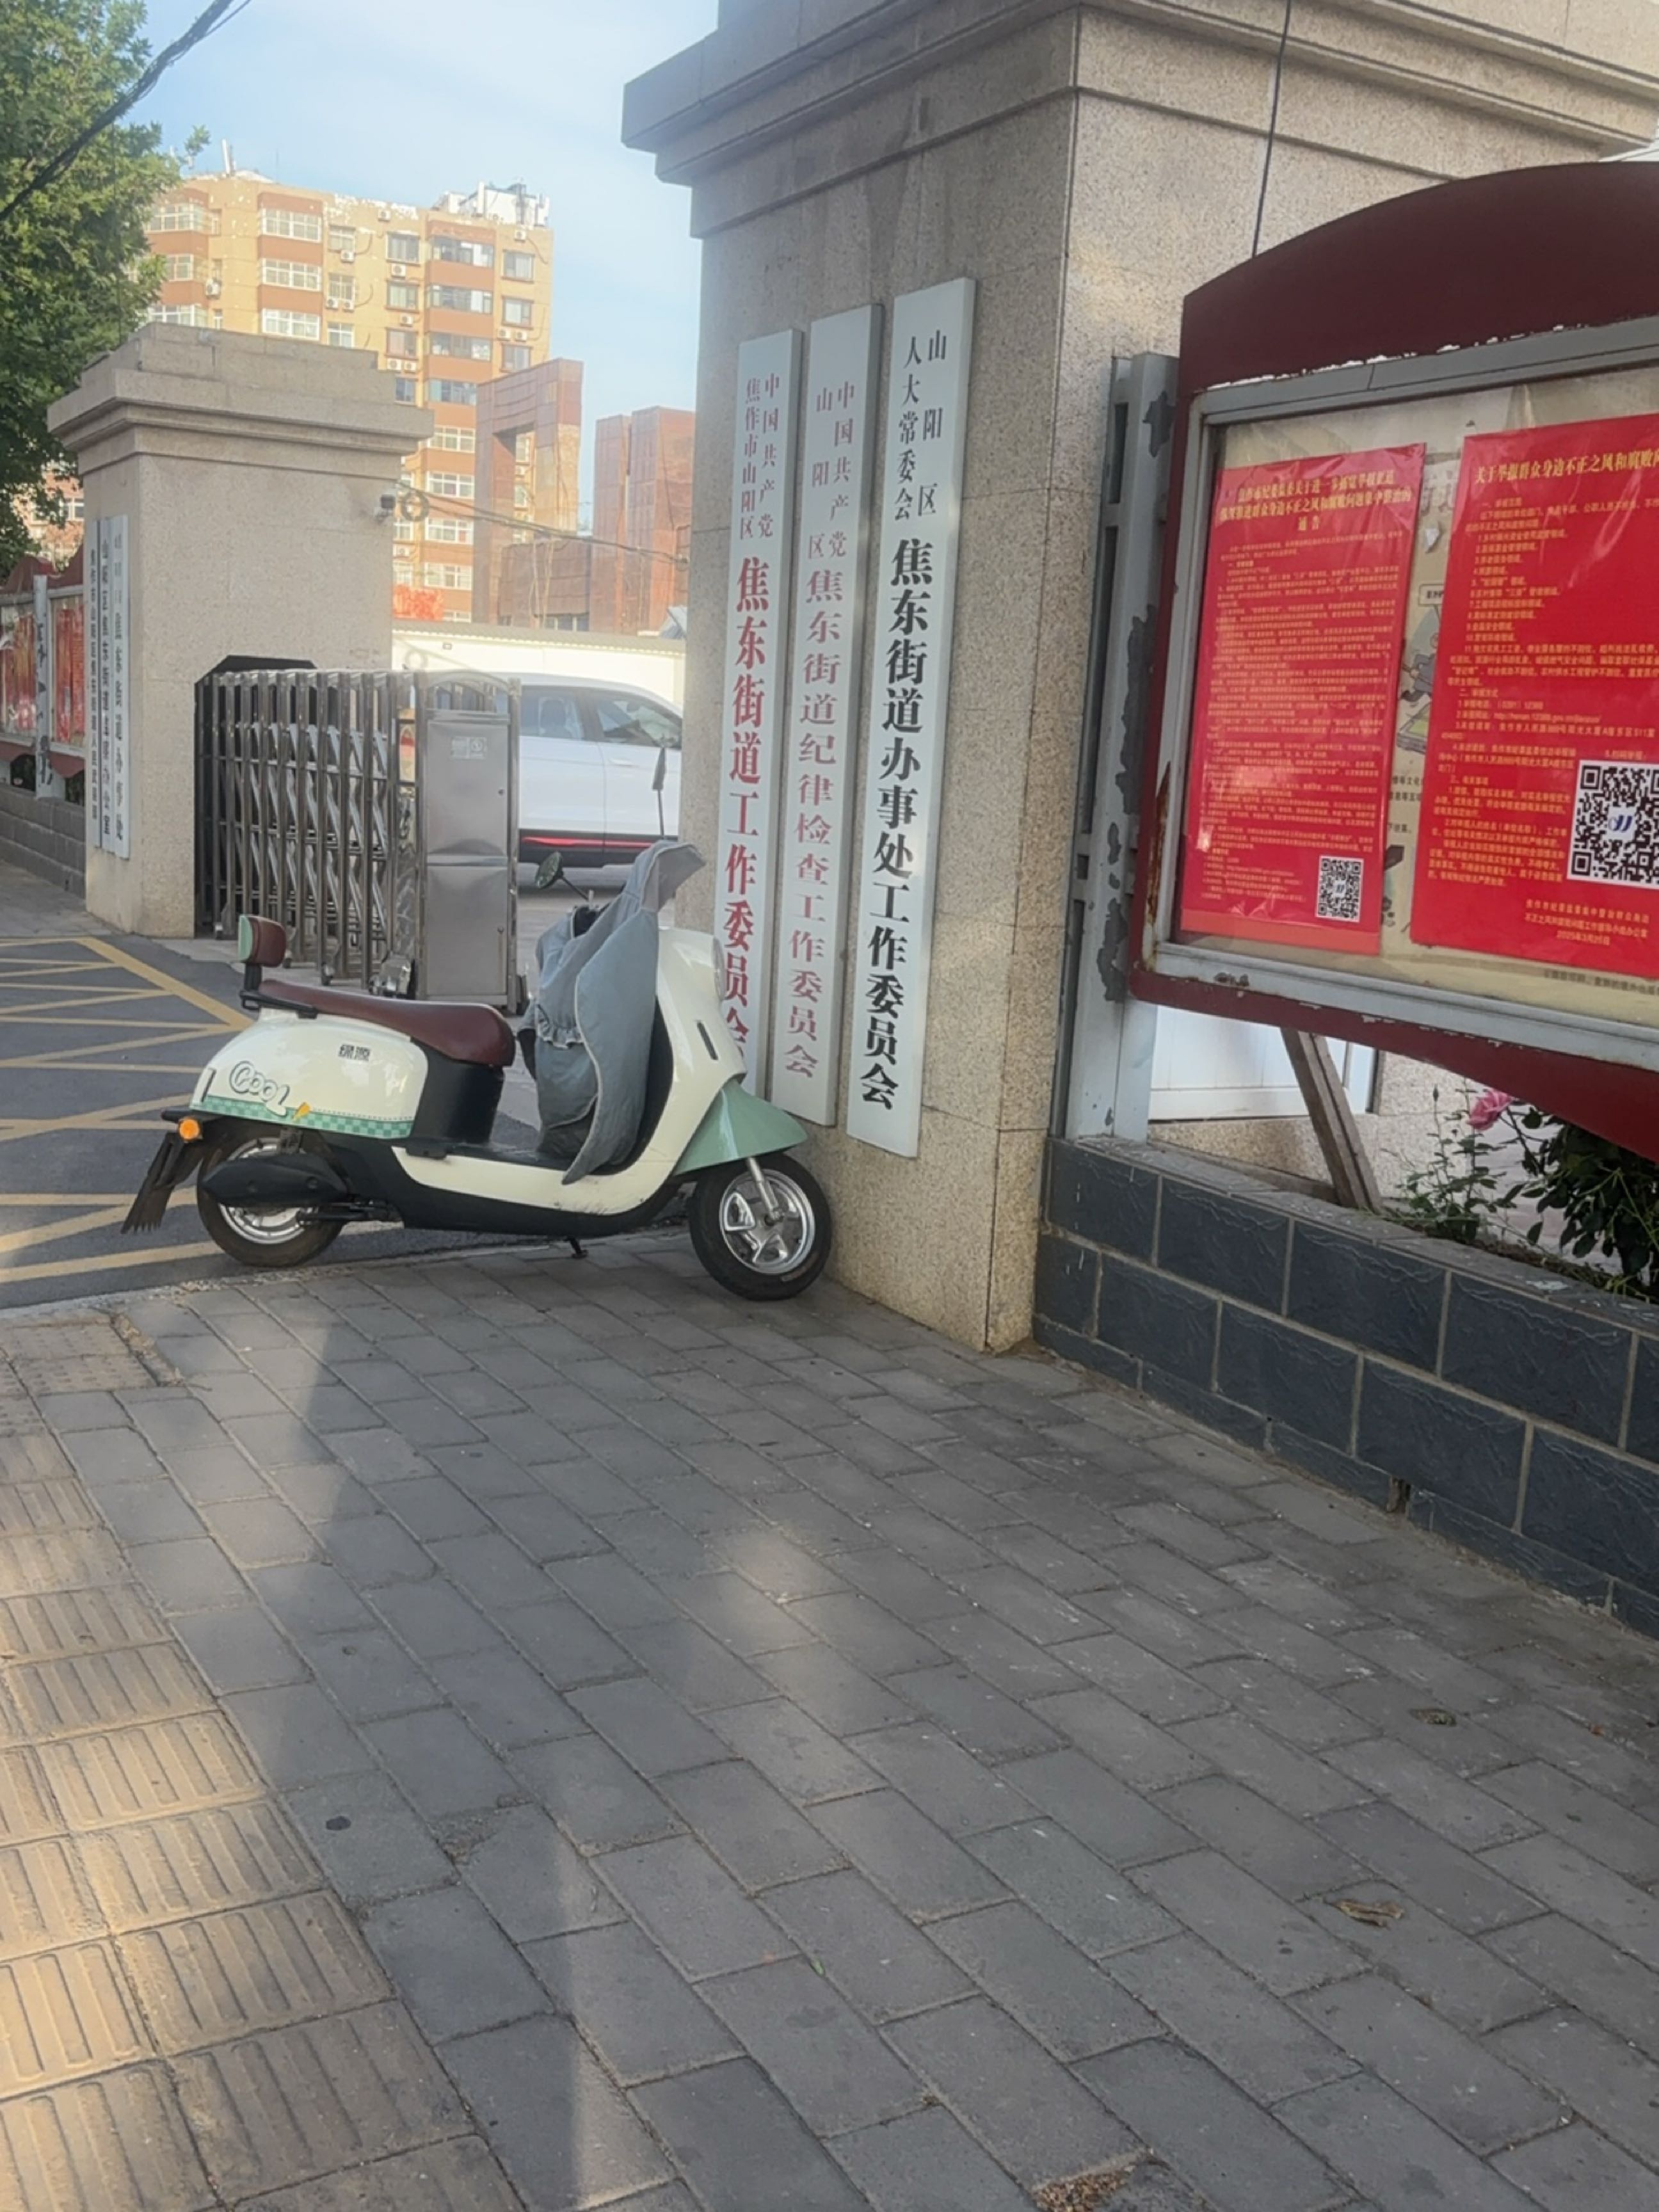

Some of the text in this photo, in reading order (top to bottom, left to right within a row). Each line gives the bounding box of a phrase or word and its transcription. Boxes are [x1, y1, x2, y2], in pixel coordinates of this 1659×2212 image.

[740, 378, 761, 540] 焦作市山阳区
[758, 373, 780, 539] 中国共产党
[808, 387, 833, 559] 山阳区
[829, 381, 855, 559] 中国共产党
[894, 336, 922, 521] 人大常委会
[918, 330, 947, 517] 山阳区
[784, 569, 843, 1078] 焦东街道纪律检查工作委员会
[860, 538, 933, 1110] 焦东街道办事处工作委员会
